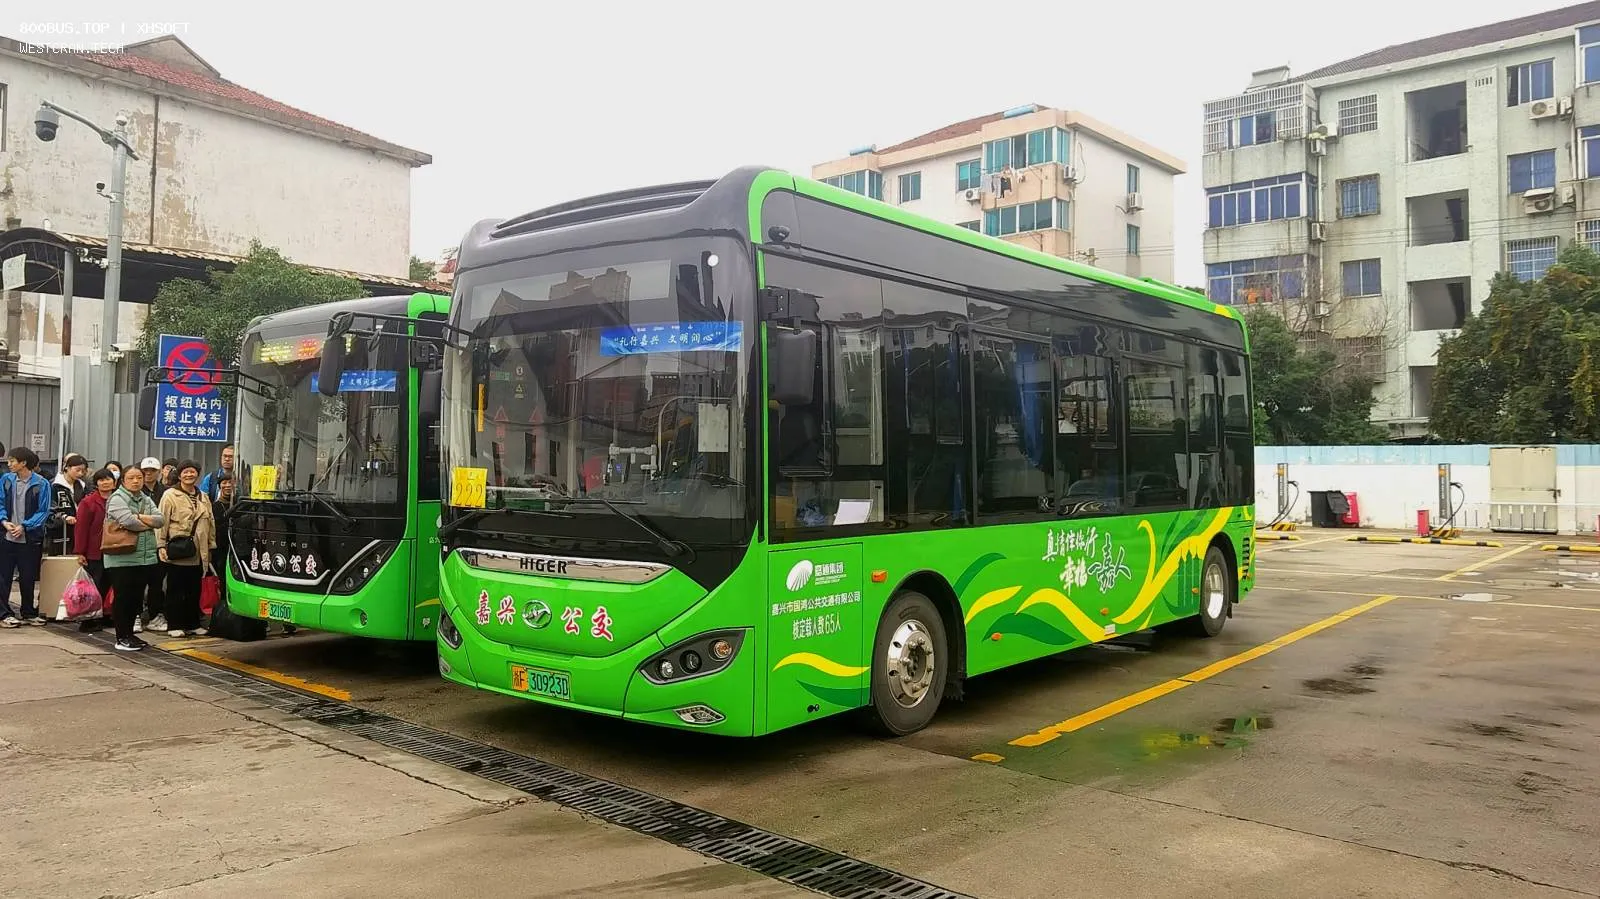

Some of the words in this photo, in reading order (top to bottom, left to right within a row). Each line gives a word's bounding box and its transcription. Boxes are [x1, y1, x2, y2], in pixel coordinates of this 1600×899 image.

[164, 395, 222, 410] 枢纽站内
[164, 410, 222, 425] 禁止停车
[519, 557, 568, 574] HIGER
[476, 590, 516, 626] 嘉兴
[561, 605, 614, 642] 公交
